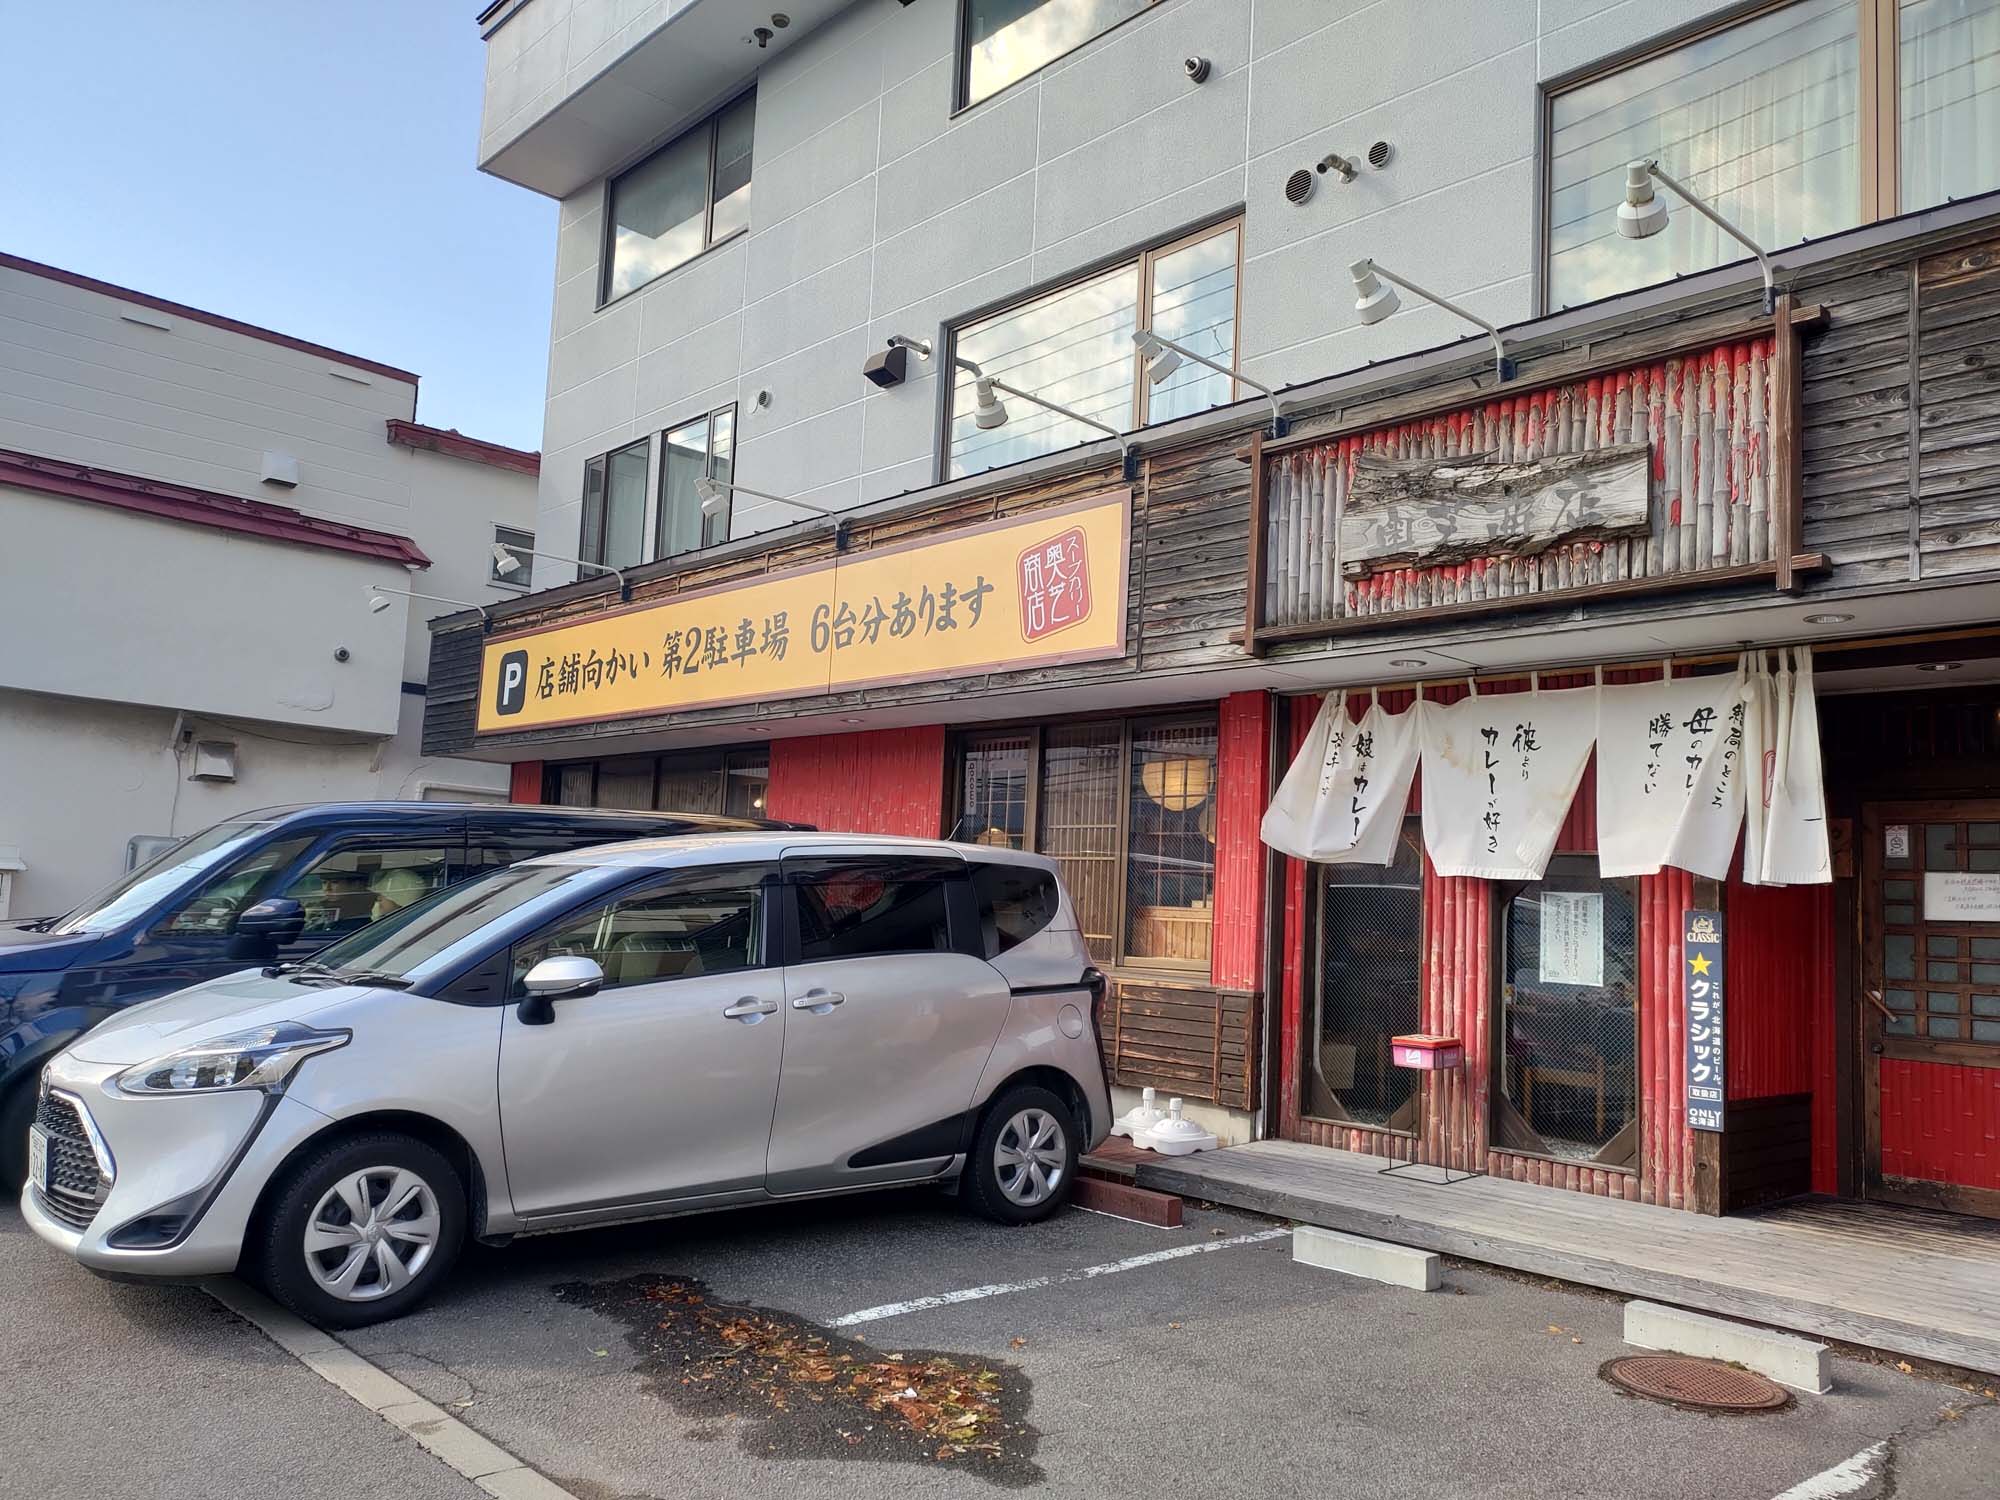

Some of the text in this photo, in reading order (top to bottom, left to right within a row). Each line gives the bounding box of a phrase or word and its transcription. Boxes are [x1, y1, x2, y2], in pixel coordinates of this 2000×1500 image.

[1023, 552, 1045, 636] 商店
[1044, 543, 1070, 625] 奥芝
[1066, 535, 1083, 617] スープカリー
[502, 574, 995, 706] P 店舗向かい 第2駐車場 6台分あります
[1481, 726, 1502, 854] カレーが好き
[1513, 722, 1541, 780] 彼より
[1644, 712, 1674, 794] 勝てない
[1682, 707, 1718, 797] 母のカレ
[1686, 932, 1720, 944] CLASSIC
[1690, 979, 1711, 1083] クラシック
[1689, 1107, 1722, 1121] ONLY
[1691, 1088, 1718, 1099] 取扱店
